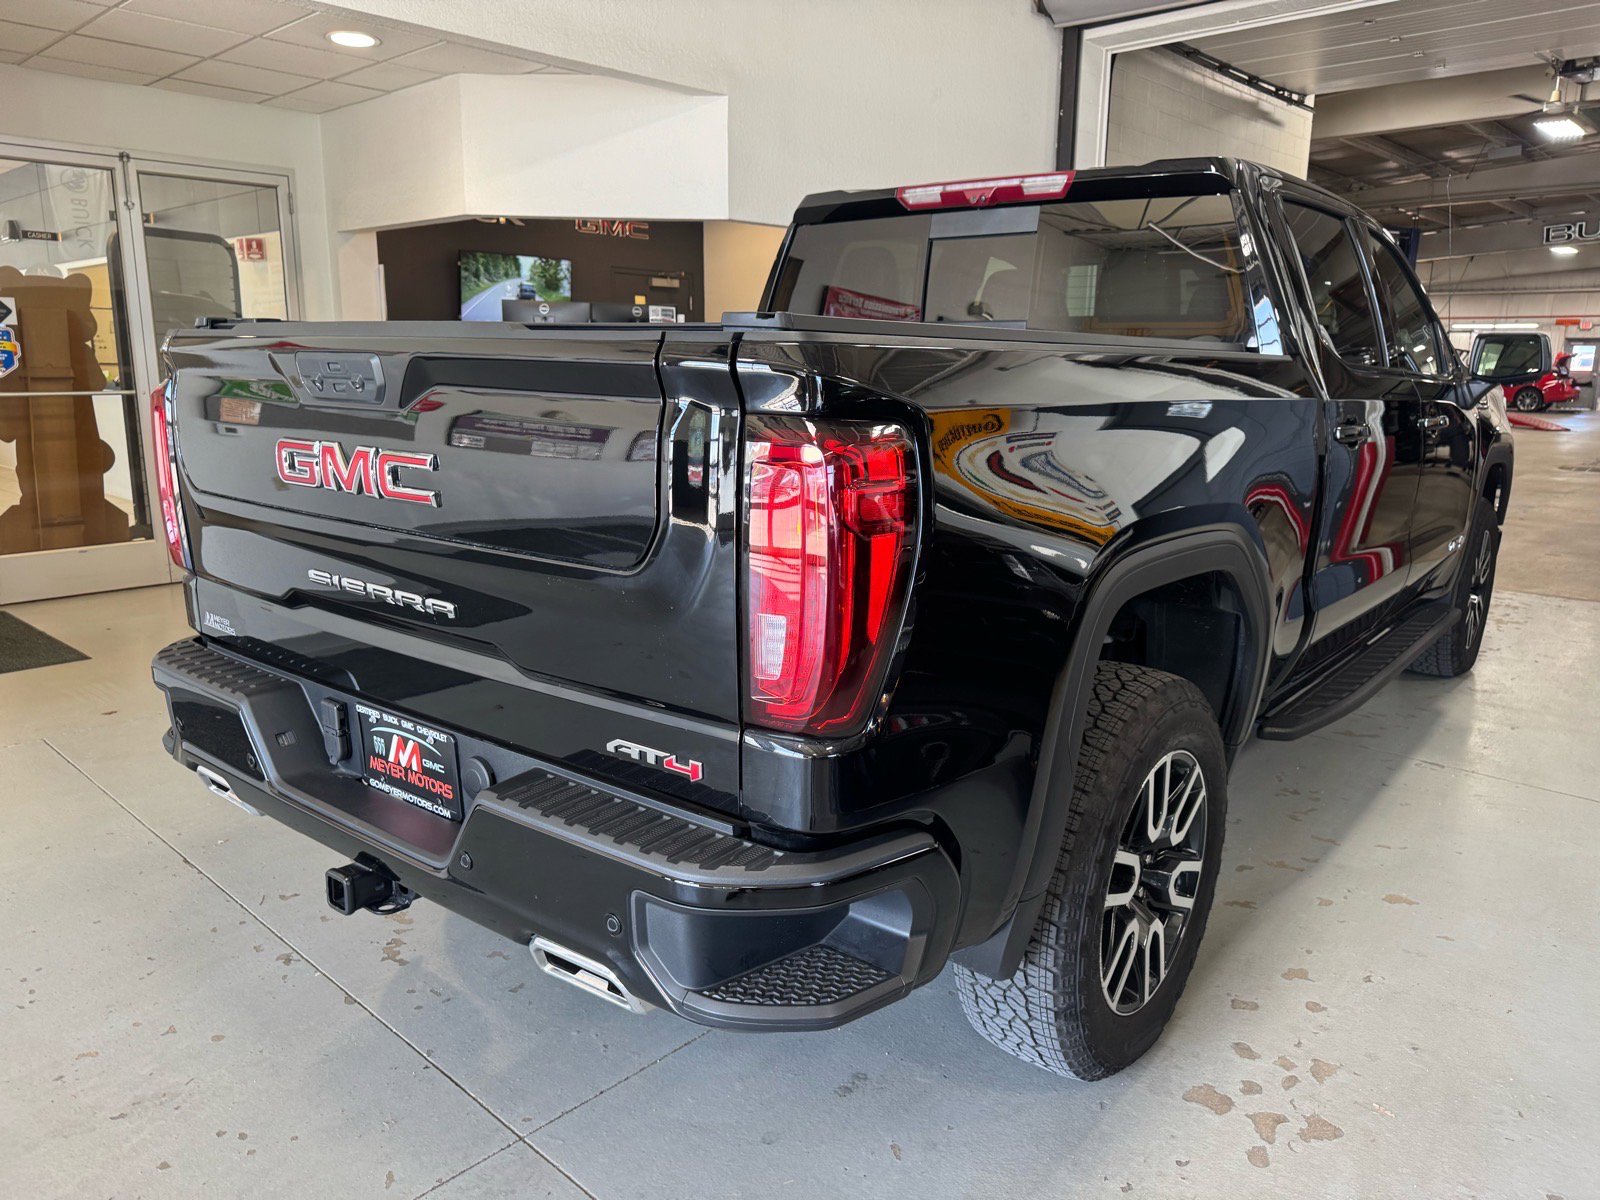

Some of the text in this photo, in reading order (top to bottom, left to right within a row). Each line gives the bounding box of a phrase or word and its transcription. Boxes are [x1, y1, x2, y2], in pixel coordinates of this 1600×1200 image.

[575, 218, 650, 239] GMC
[275, 437, 443, 508] GMC
[307, 568, 457, 619] SIERRA
[356, 705, 447, 743] CERTIFIED BUICK GMC CHEVROLET
[370, 756, 453, 799] MEYER MOTORS
[423, 759, 445, 773] GMC
[606, 739, 703, 782] AT4
[370, 779, 451, 819] GOMEYERMOTORS.COM
